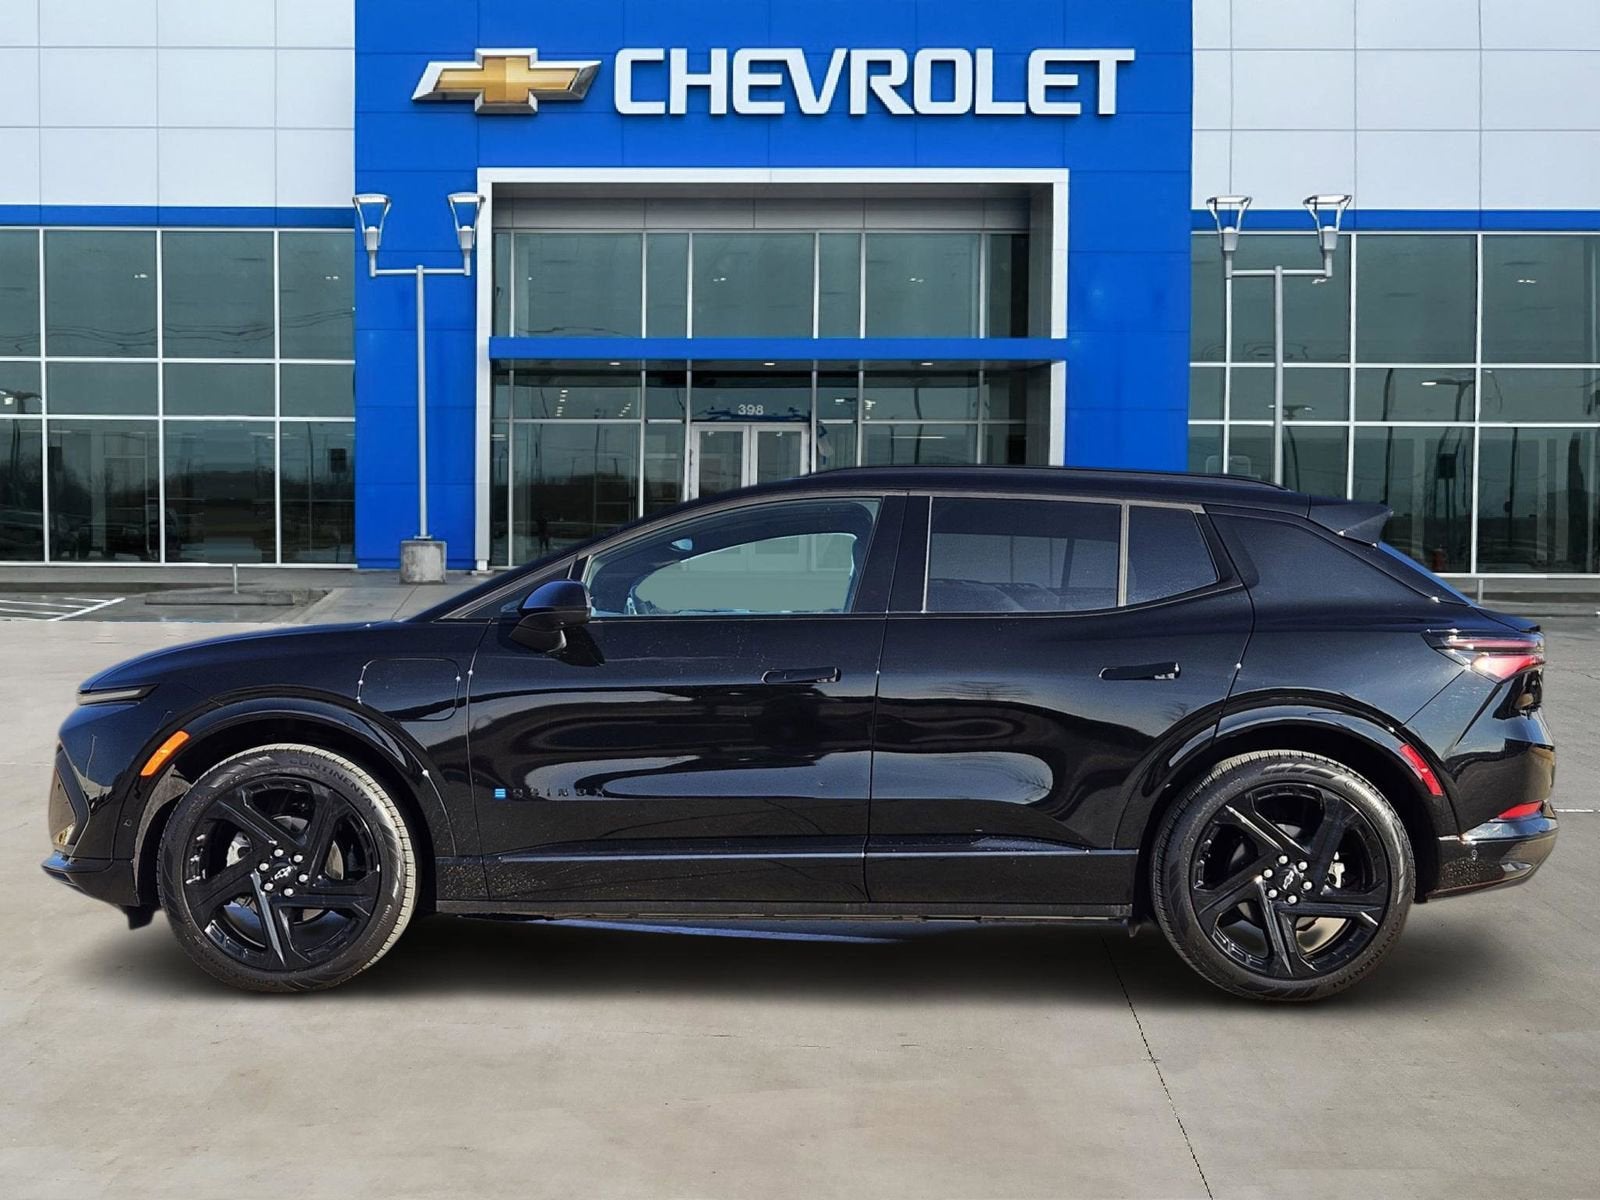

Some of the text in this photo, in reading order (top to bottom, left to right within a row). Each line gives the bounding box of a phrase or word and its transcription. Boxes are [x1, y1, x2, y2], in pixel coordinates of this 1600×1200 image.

[615, 48, 1135, 115] CHEVROLET
[738, 404, 764, 416] 398
[289, 758, 378, 811] CONTINENTAL
